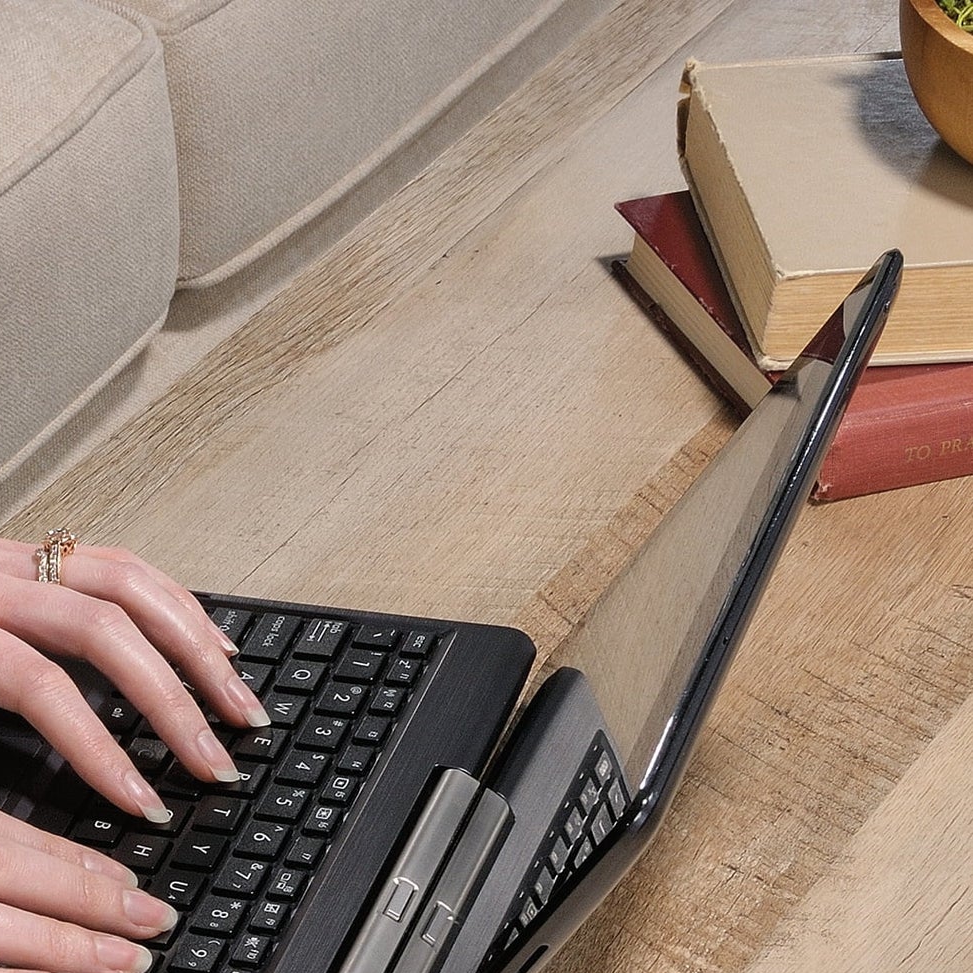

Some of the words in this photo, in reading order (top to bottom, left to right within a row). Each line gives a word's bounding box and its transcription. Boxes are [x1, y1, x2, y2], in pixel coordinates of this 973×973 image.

[905, 445, 931, 462] TO
[222, 610, 238, 625] shift
[272, 616, 285, 632] caps
[329, 621, 343, 634] tab
[261, 633, 280, 647] lock
[412, 635, 426, 648] esc
[238, 671, 255, 682] A
[291, 669, 311, 680] Q
[349, 686, 362, 695] @
[333, 693, 351, 702] 2
[111, 707, 124, 718] alt
[273, 702, 293, 715] W
[315, 727, 332, 736] 3
[253, 736, 272, 746] E
[295, 761, 311, 771] 4
[292, 789, 306, 798] %
[276, 796, 293, 807] 5
[213, 808, 231, 817] T
[94, 820, 112, 830] B
[253, 832, 272, 842] 6
[133, 844, 153, 857] H
[192, 845, 211, 854] Y
[301, 852, 312, 861] f7
[250, 862, 264, 871] &
[235, 870, 252, 880] 7
[169, 881, 189, 892] U
[211, 909, 229, 919] 8
[190, 948, 208, 958] 9
